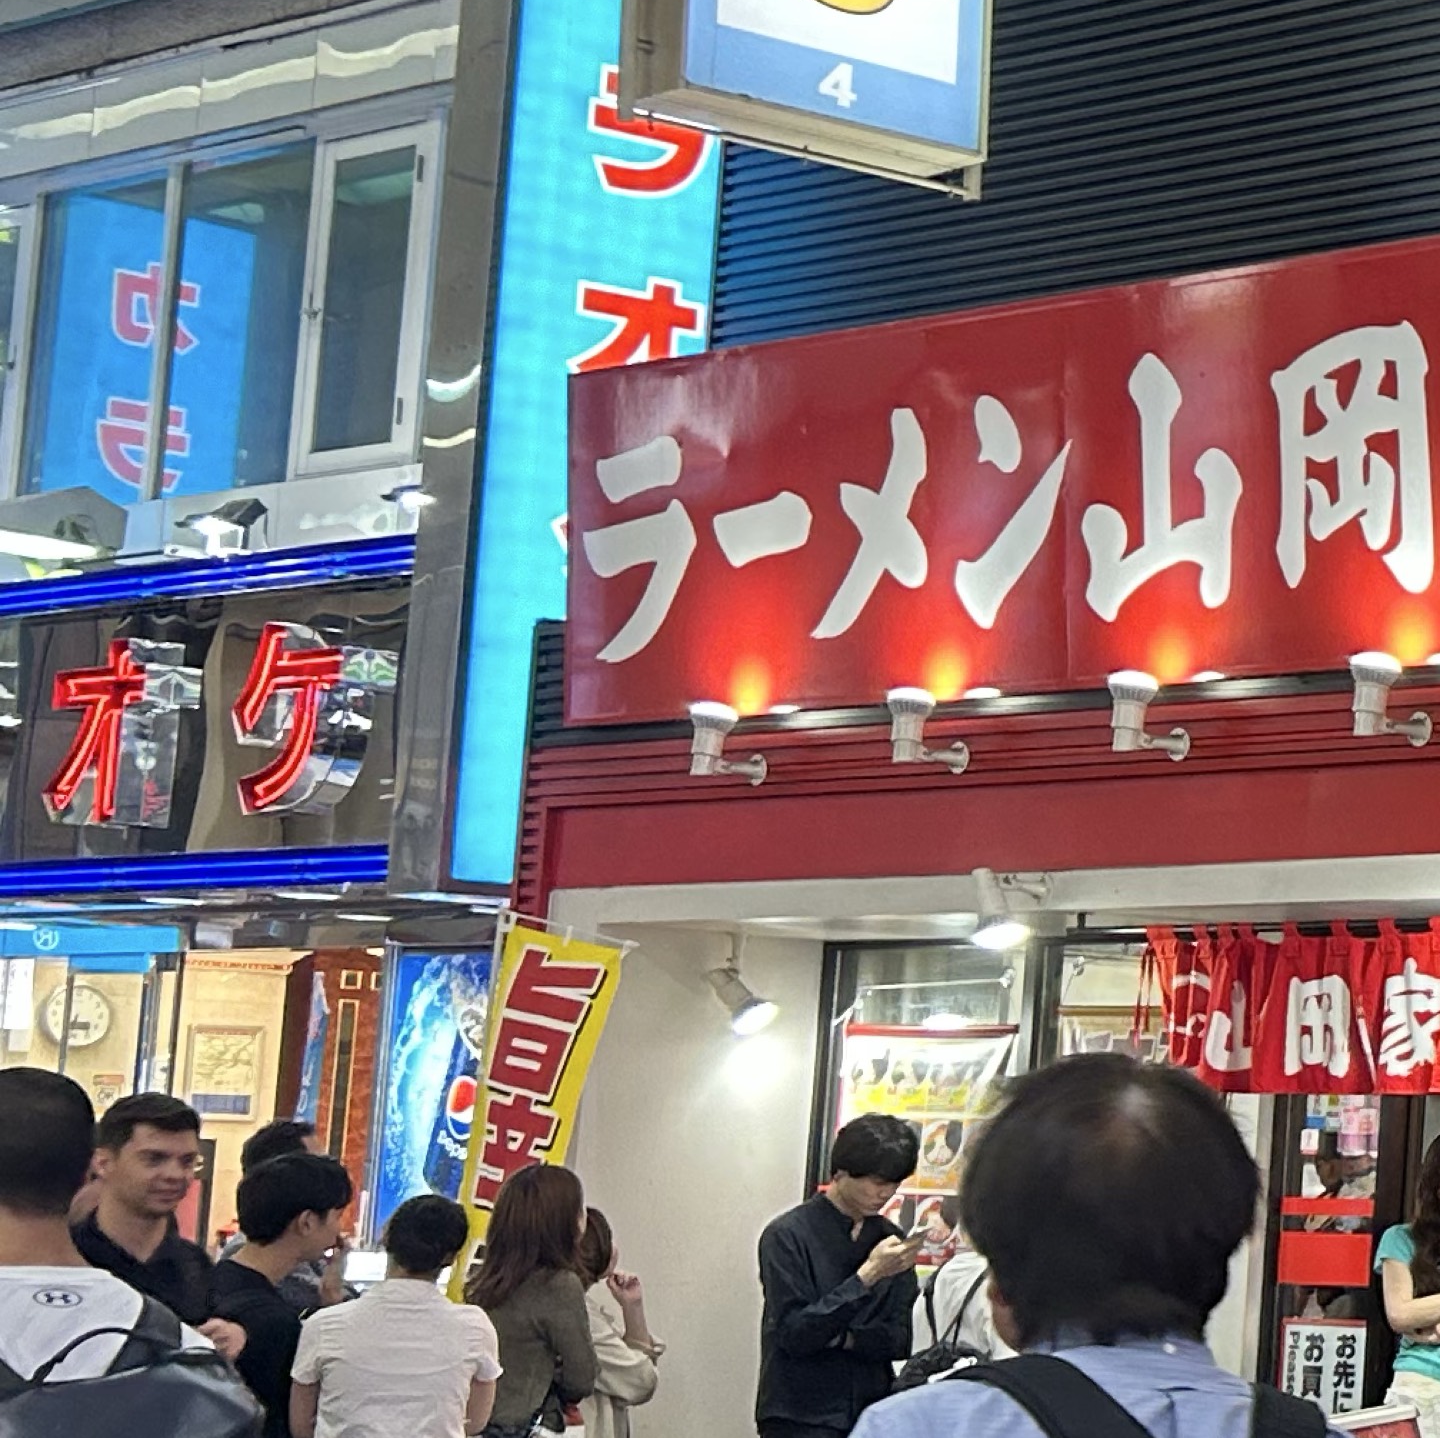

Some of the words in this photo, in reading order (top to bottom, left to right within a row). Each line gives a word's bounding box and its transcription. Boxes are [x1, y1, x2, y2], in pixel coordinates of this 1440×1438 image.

[817, 62, 859, 109] 4
[1332, 1333, 1358, 1415] お先に
